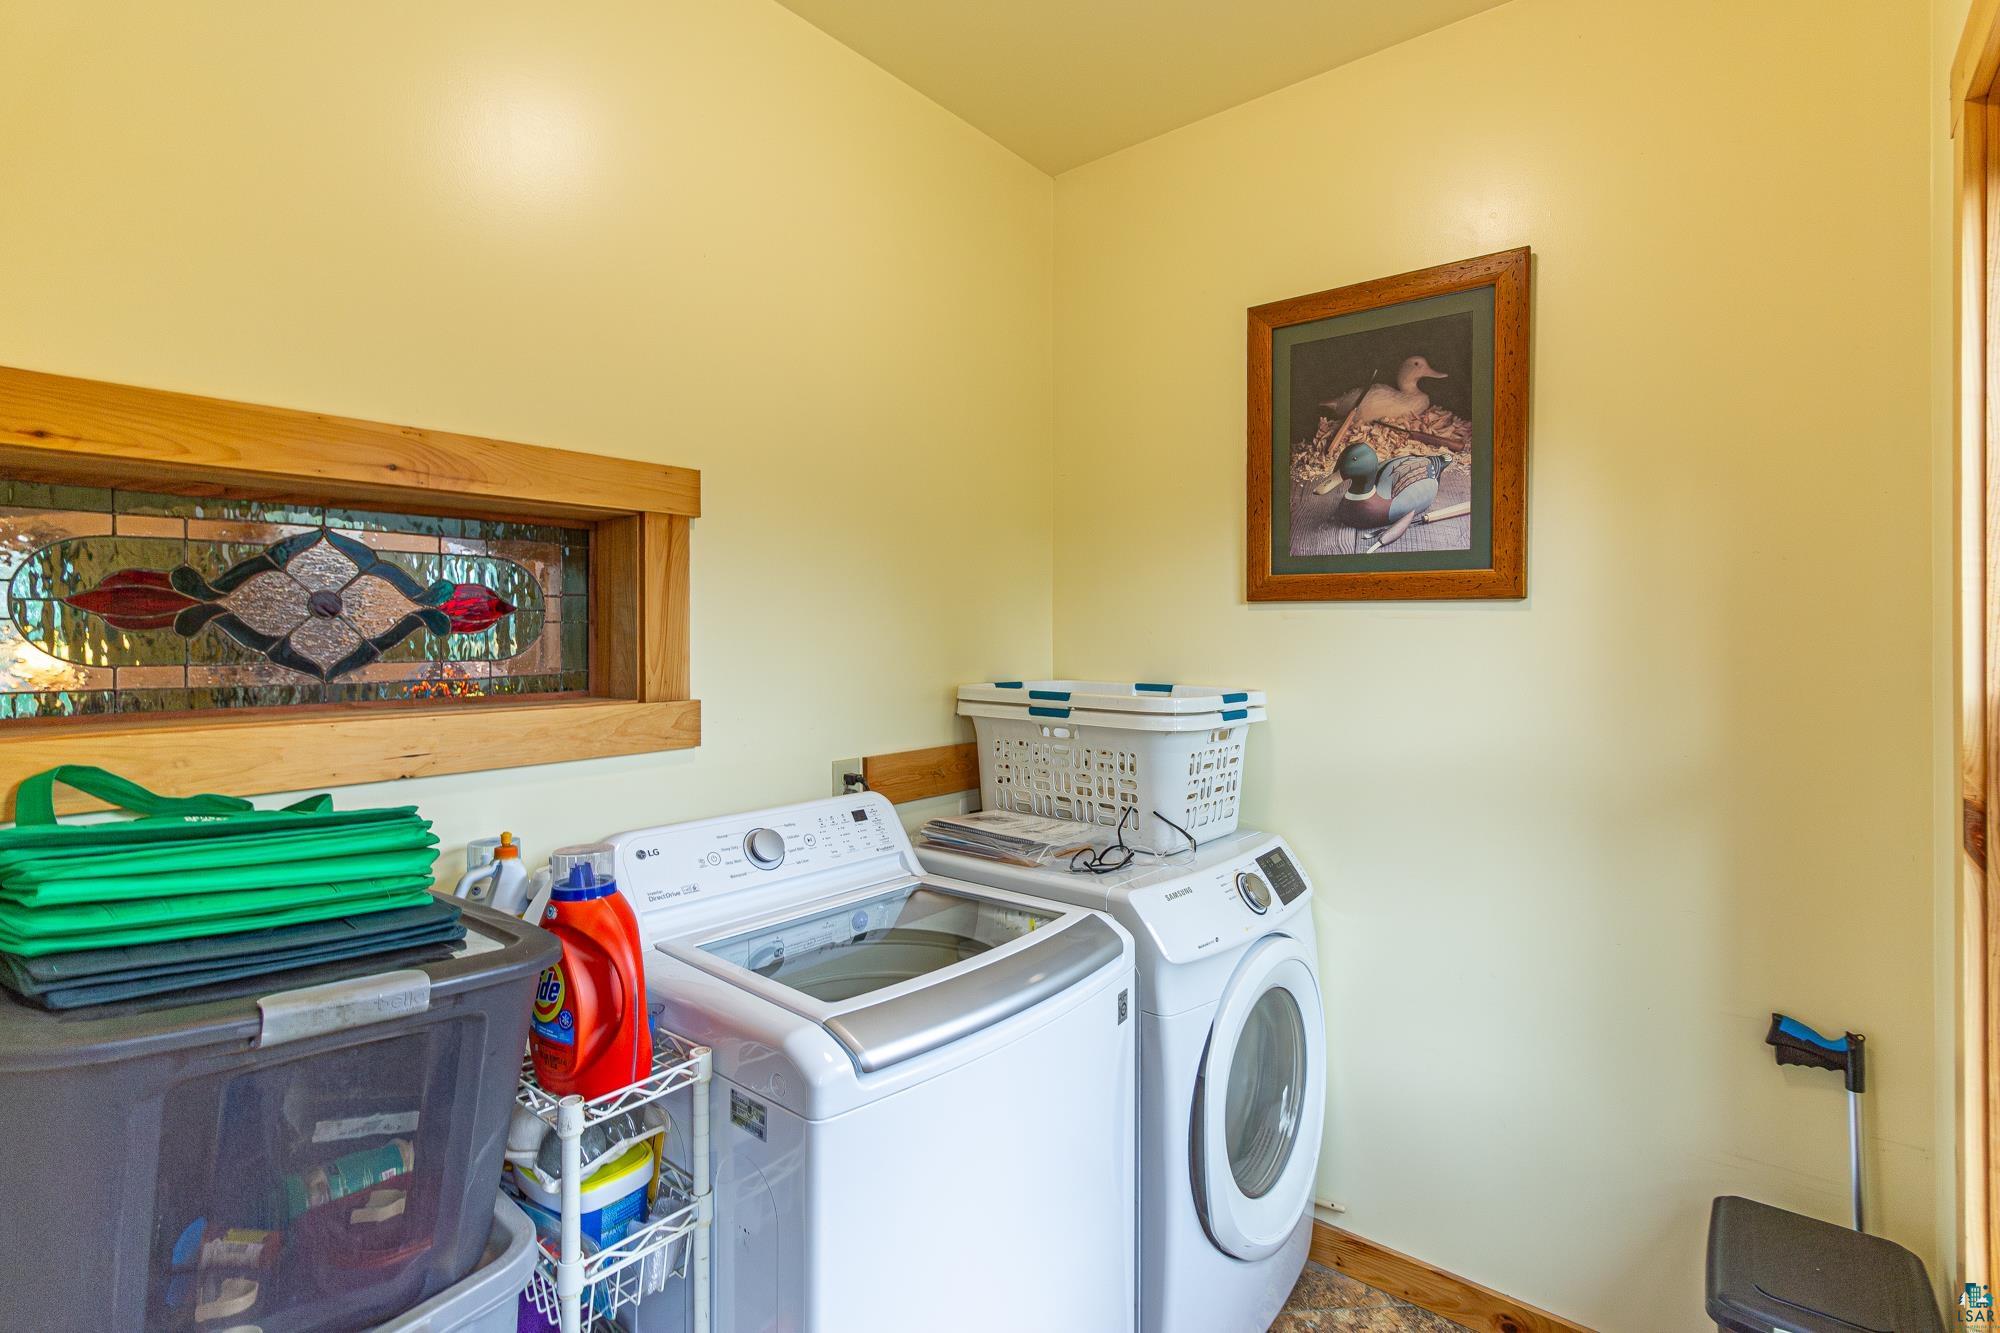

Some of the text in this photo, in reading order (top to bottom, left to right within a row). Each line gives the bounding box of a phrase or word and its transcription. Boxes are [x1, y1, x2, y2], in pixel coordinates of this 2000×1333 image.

[647, 848, 660, 857] LG
[1164, 886, 1193, 902] SAMSUNG
[535, 969, 561, 1002] ide
